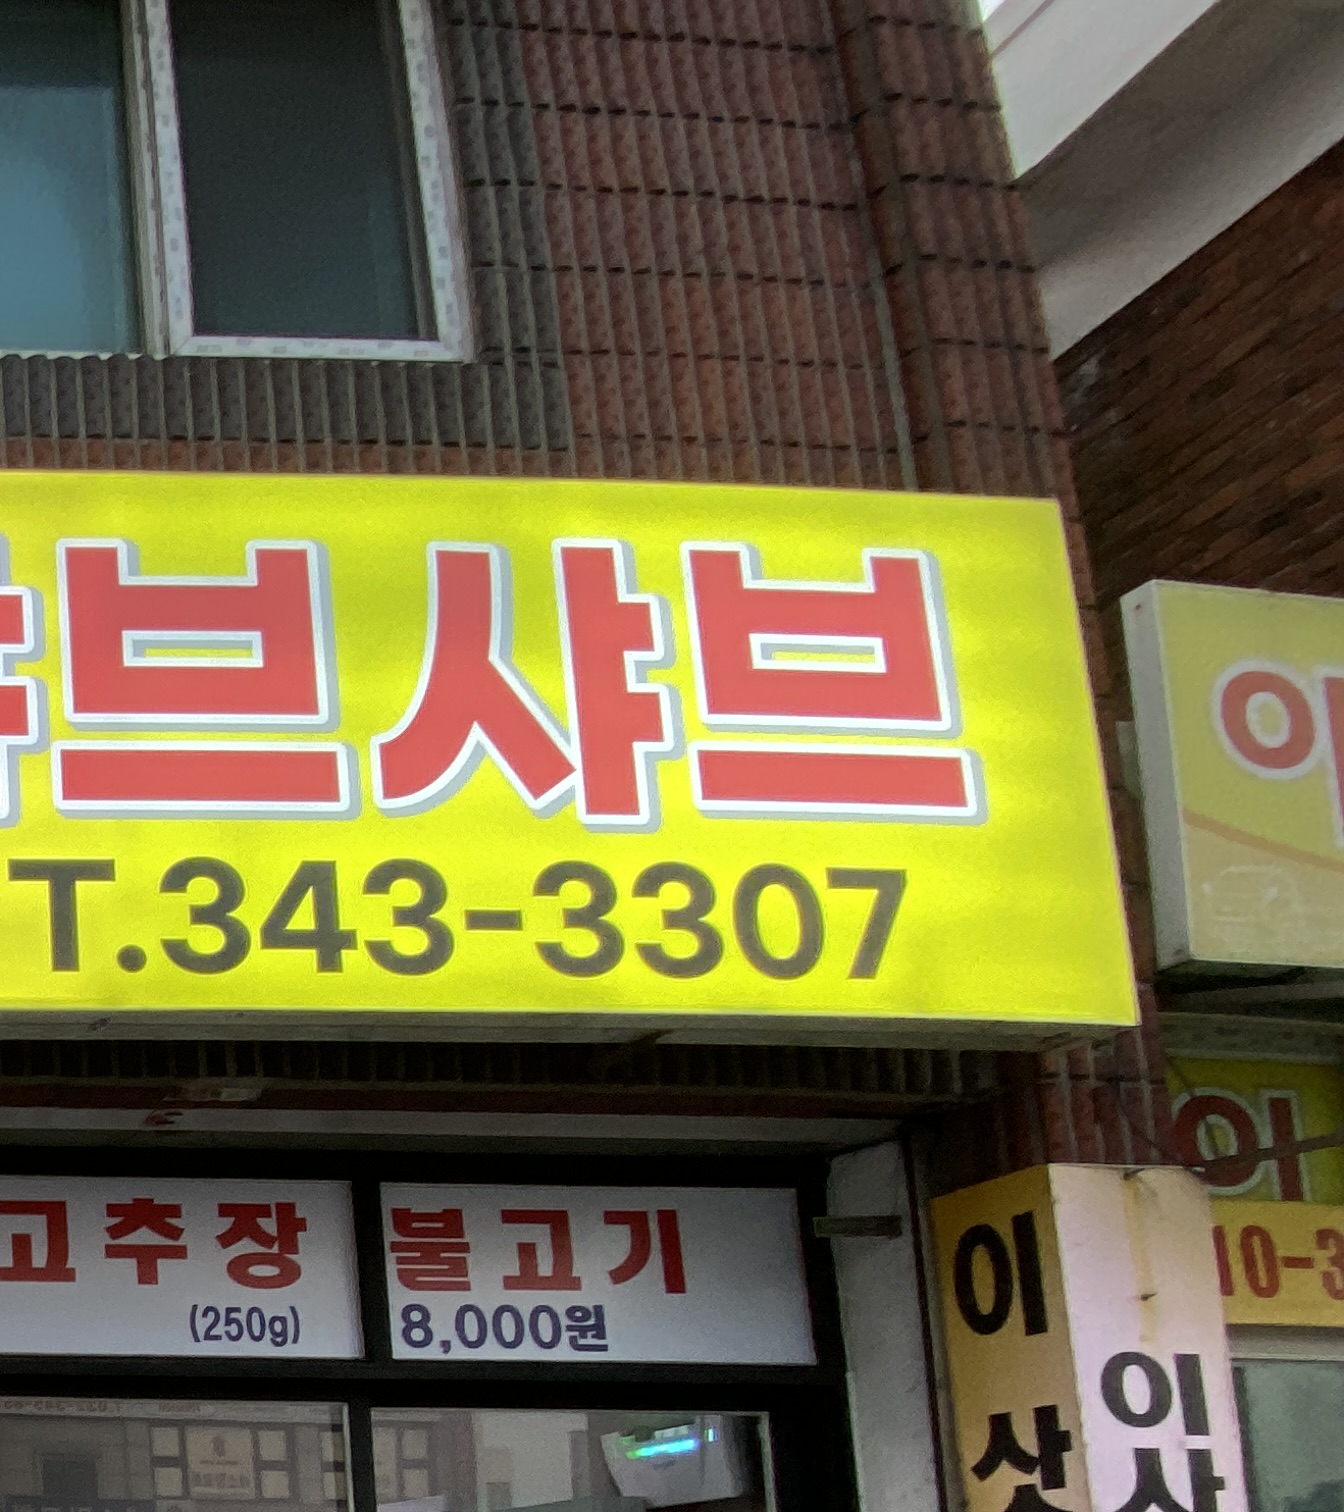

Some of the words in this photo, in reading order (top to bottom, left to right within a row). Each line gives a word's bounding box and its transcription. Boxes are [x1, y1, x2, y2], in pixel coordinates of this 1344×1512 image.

[7, 857, 908, 982] T.343-3307
[390, 1207, 687, 1295] 불고기
[190, 1304, 300, 1347] (250g)
[400, 1303, 609, 1355] 8,000원
